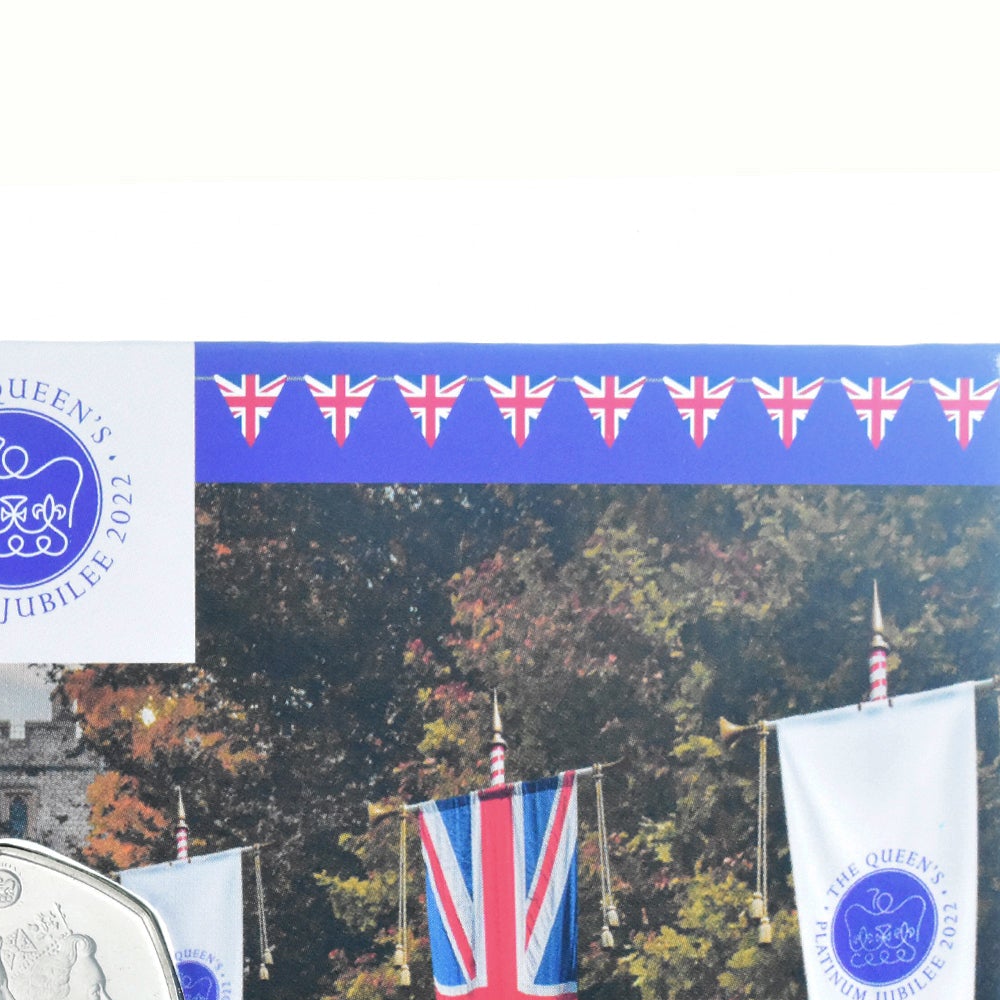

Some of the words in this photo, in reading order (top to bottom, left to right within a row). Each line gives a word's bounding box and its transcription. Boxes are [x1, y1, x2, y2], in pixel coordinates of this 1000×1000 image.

[0, 550, 114, 624] JUBILEE
[106, 473, 133, 544] 2022
[826, 862, 860, 899] THE
[865, 848, 945, 885] QUEEN'S
[939, 901, 958, 950] 2022
